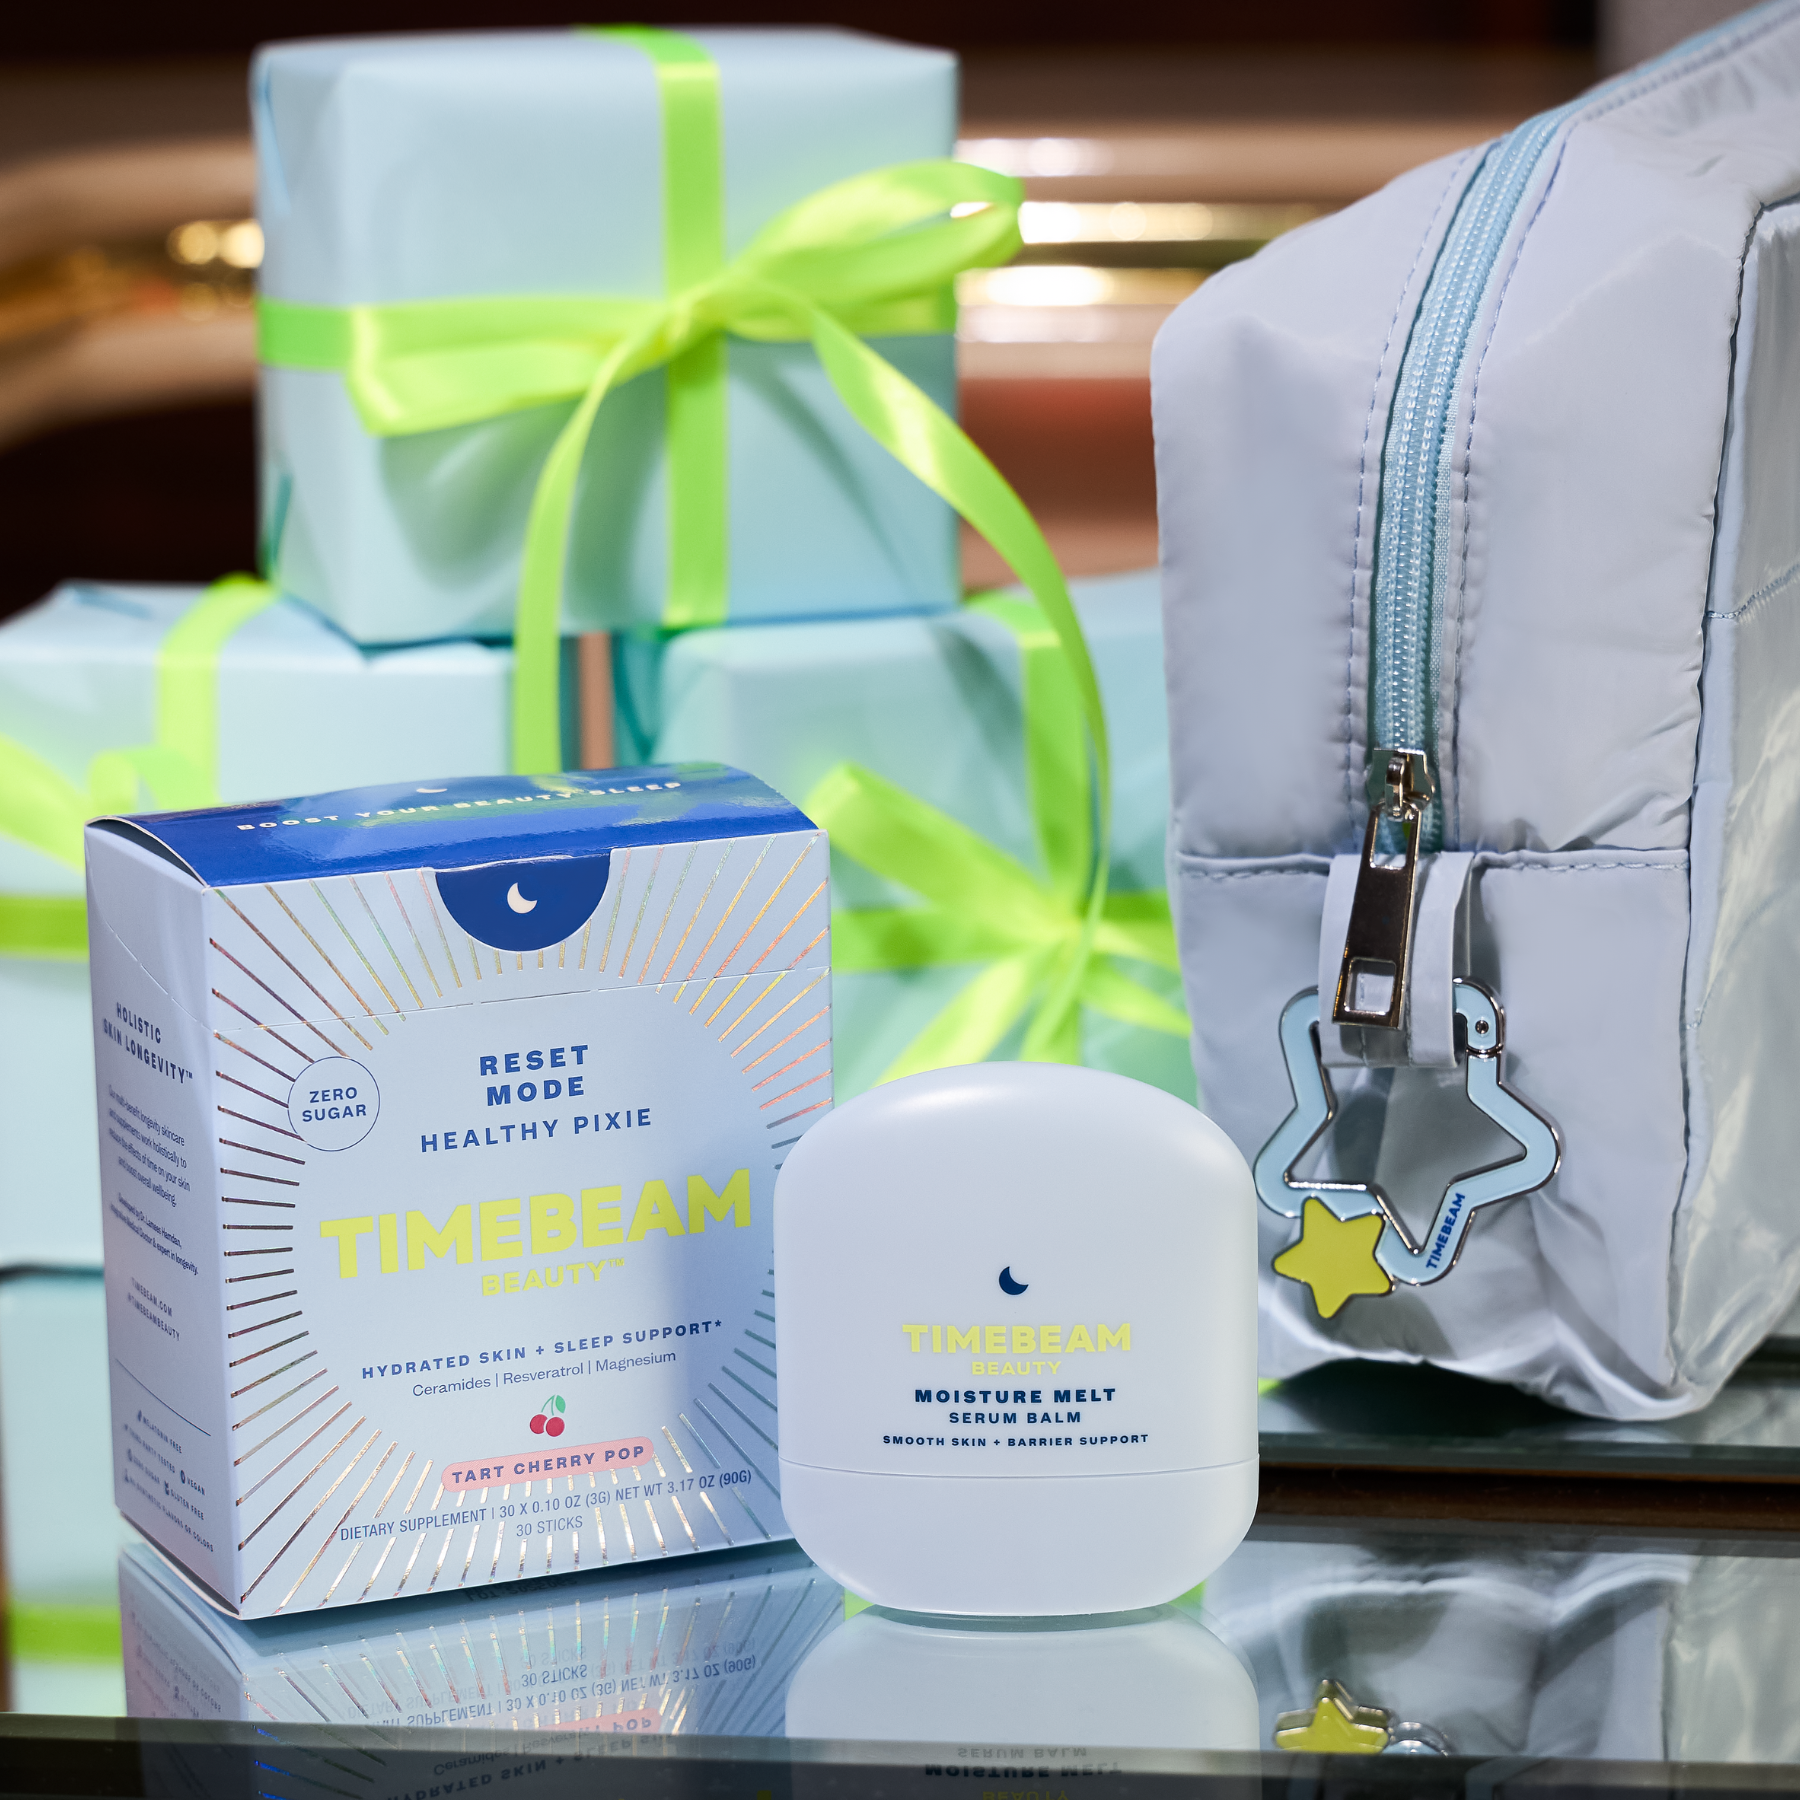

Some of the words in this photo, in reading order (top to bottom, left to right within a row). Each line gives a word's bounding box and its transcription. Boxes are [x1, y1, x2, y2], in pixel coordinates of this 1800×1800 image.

[237, 814, 339, 831] BOOST
[355, 805, 441, 818] YOUR
[454, 792, 573, 809] BEAUTY
[589, 782, 682, 796] SLEEP
[103, 1018, 122, 1046] SKIN
[116, 1001, 161, 1044] HOLISTIC
[479, 1044, 589, 1076] RESET
[308, 1086, 358, 1104] ZERO
[486, 1076, 585, 1107] MODE
[302, 1104, 367, 1123] SUGAR
[161, 1125, 185, 1146] skincare
[420, 1118, 559, 1153] HEALTHY
[574, 1108, 652, 1134] PIXIE
[180, 1157, 187, 1169] to
[158, 1165, 165, 1177] on
[165, 1169, 177, 1184] your
[177, 1177, 191, 1192] skin
[320, 1168, 751, 1279] TIMEBEAM
[1425, 1192, 1466, 1269] TIMEBEAM
[902, 1323, 1131, 1354] TIMEBEAM
[361, 1353, 470, 1380] HYDRATED
[478, 1346, 526, 1364] SKIN
[553, 1335, 614, 1354] SLEEP
[971, 1361, 1062, 1376] BEAUTY
[412, 1374, 491, 1397] Ceramides
[503, 1363, 584, 1385] Resveratrol
[596, 1350, 676, 1374] Magnesium
[915, 1389, 1043, 1404] MOISTURE
[1053, 1388, 1116, 1403] MELT
[949, 1412, 1018, 1424] SERUM
[1027, 1411, 1082, 1424] BALM
[169, 1438, 183, 1455] FREE
[883, 1435, 945, 1446] SMOOTH
[951, 1437, 987, 1447] SKIN
[1008, 1437, 1073, 1447] BARRIER
[1080, 1434, 1149, 1446] SUPPORT
[452, 1465, 505, 1484] TART
[514, 1452, 596, 1477] CHERRY
[604, 1445, 645, 1463] POP
[187, 1476, 205, 1496] VEGAN
[190, 1504, 205, 1521] FREE
[340, 1520, 395, 1541] DIETARY
[399, 1508, 487, 1532] SUPPLEMENT
[499, 1504, 517, 1519] 30
[519, 1502, 529, 1516] X
[531, 1498, 561, 1515] 0.10
[564, 1495, 582, 1511] OZ
[585, 1491, 611, 1509] (3G)
[615, 1487, 639, 1502] NET
[643, 1483, 662, 1498] WT
[667, 1479, 696, 1496] 3.17
[699, 1474, 717, 1490] OZ
[719, 1469, 752, 1489] (90G)
[516, 1523, 534, 1537] 30
[537, 1515, 583, 1535] STICKS
[192, 1530, 214, 1553] COLORS
